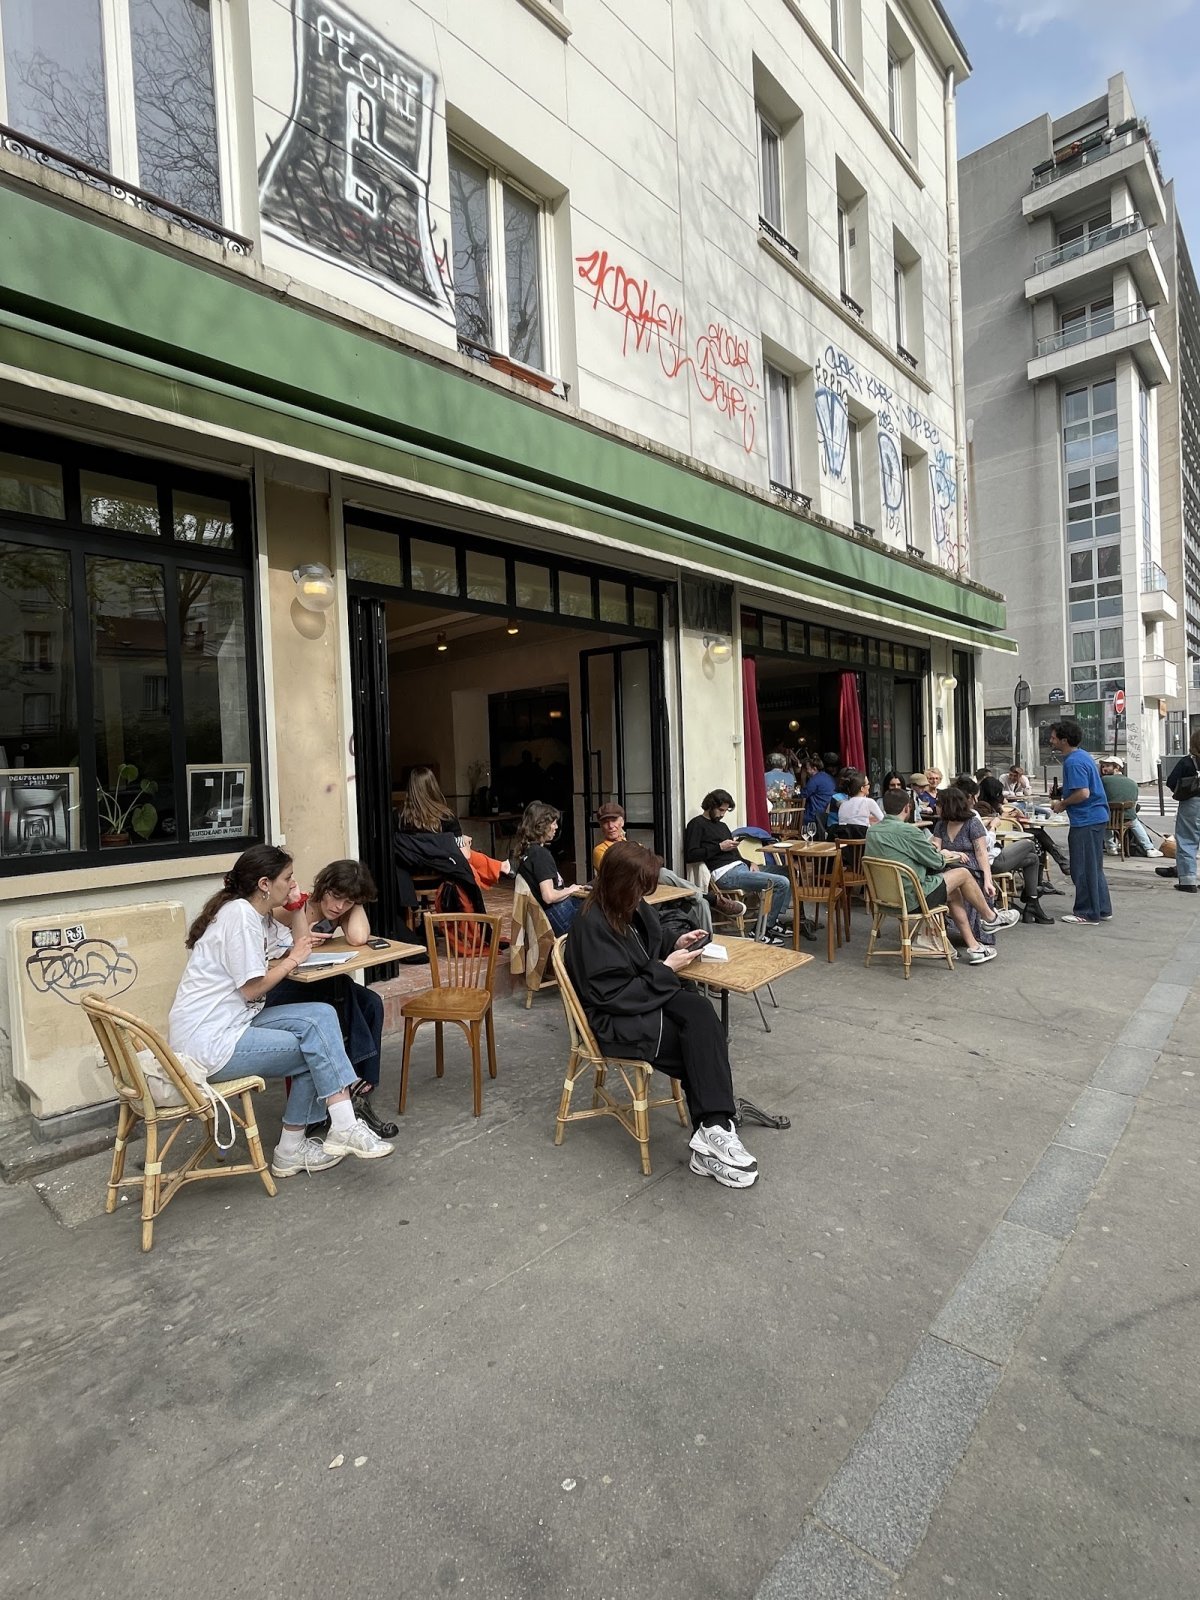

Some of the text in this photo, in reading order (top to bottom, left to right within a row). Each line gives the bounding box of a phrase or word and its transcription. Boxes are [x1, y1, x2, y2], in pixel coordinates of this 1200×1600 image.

[8, 773, 61, 782] DEUTSCHLAND
[189, 828, 222, 837] DEUTSCHLAND
[714, 1136, 725, 1146] N
[712, 1162, 723, 1172] N
